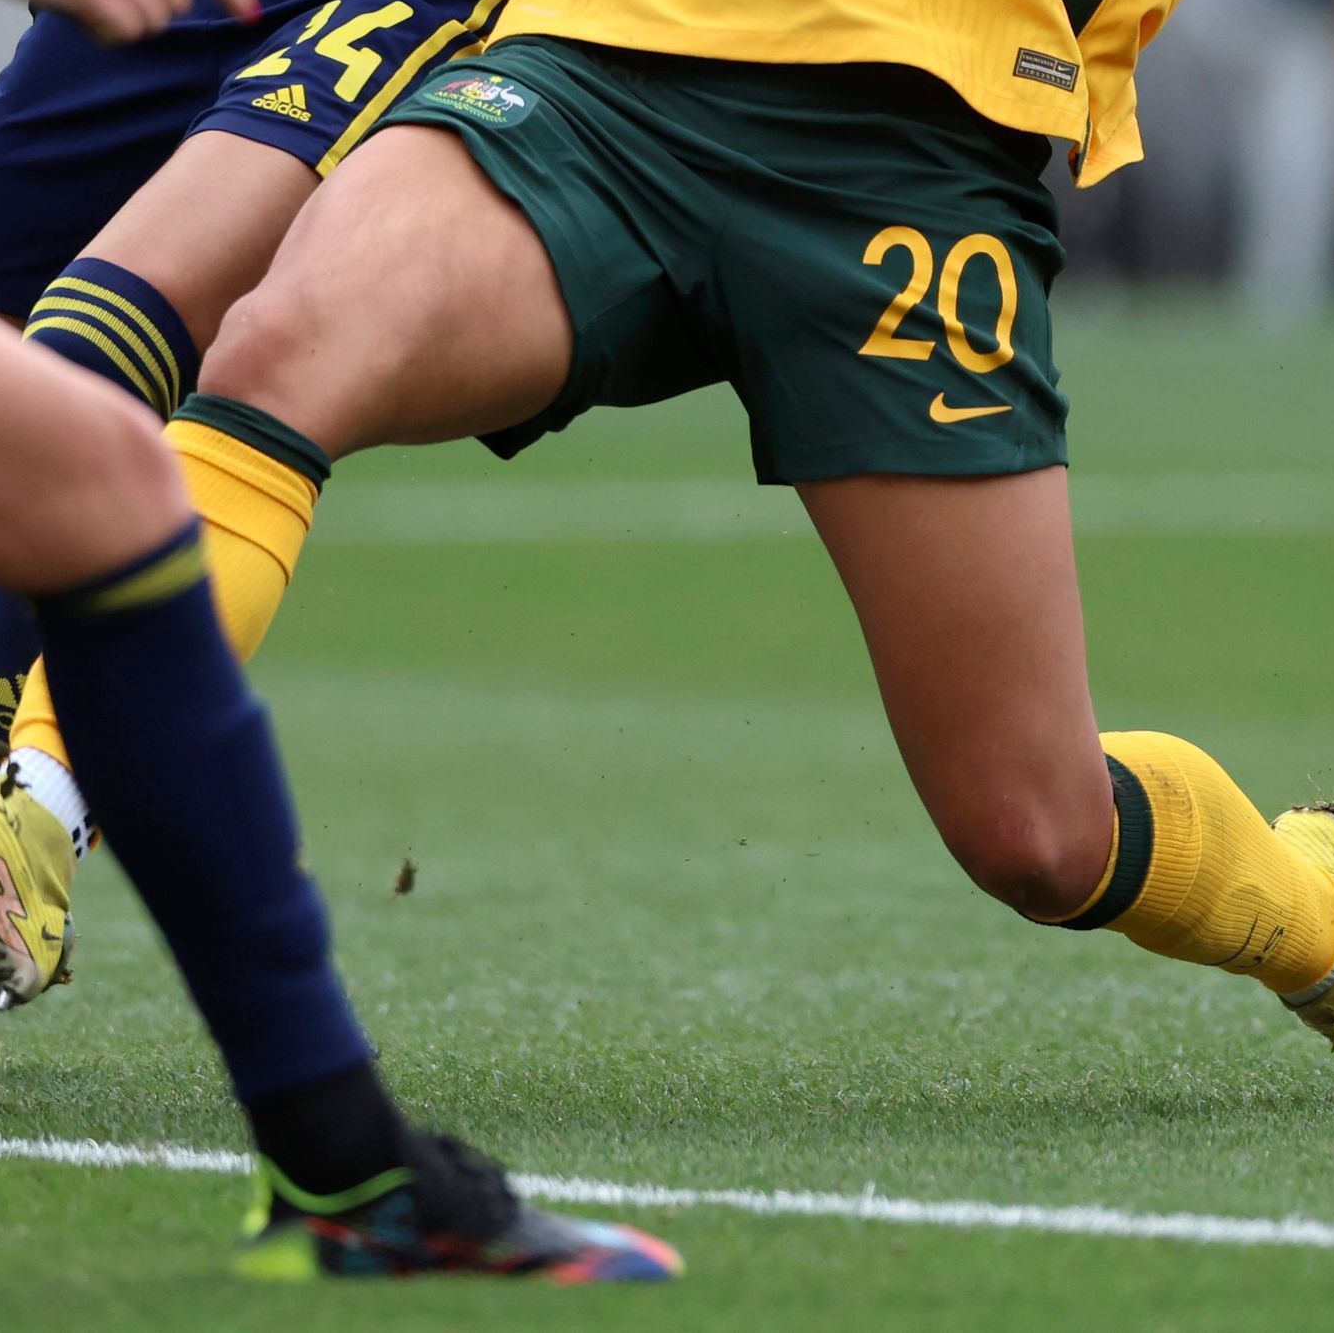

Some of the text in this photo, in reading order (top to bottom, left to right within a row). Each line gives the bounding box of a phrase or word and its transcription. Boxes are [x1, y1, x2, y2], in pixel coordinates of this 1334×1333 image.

[251, 97, 312, 122] adidas
[435, 90, 502, 116] AUSTRALIA
[857, 225, 1019, 374] 20
